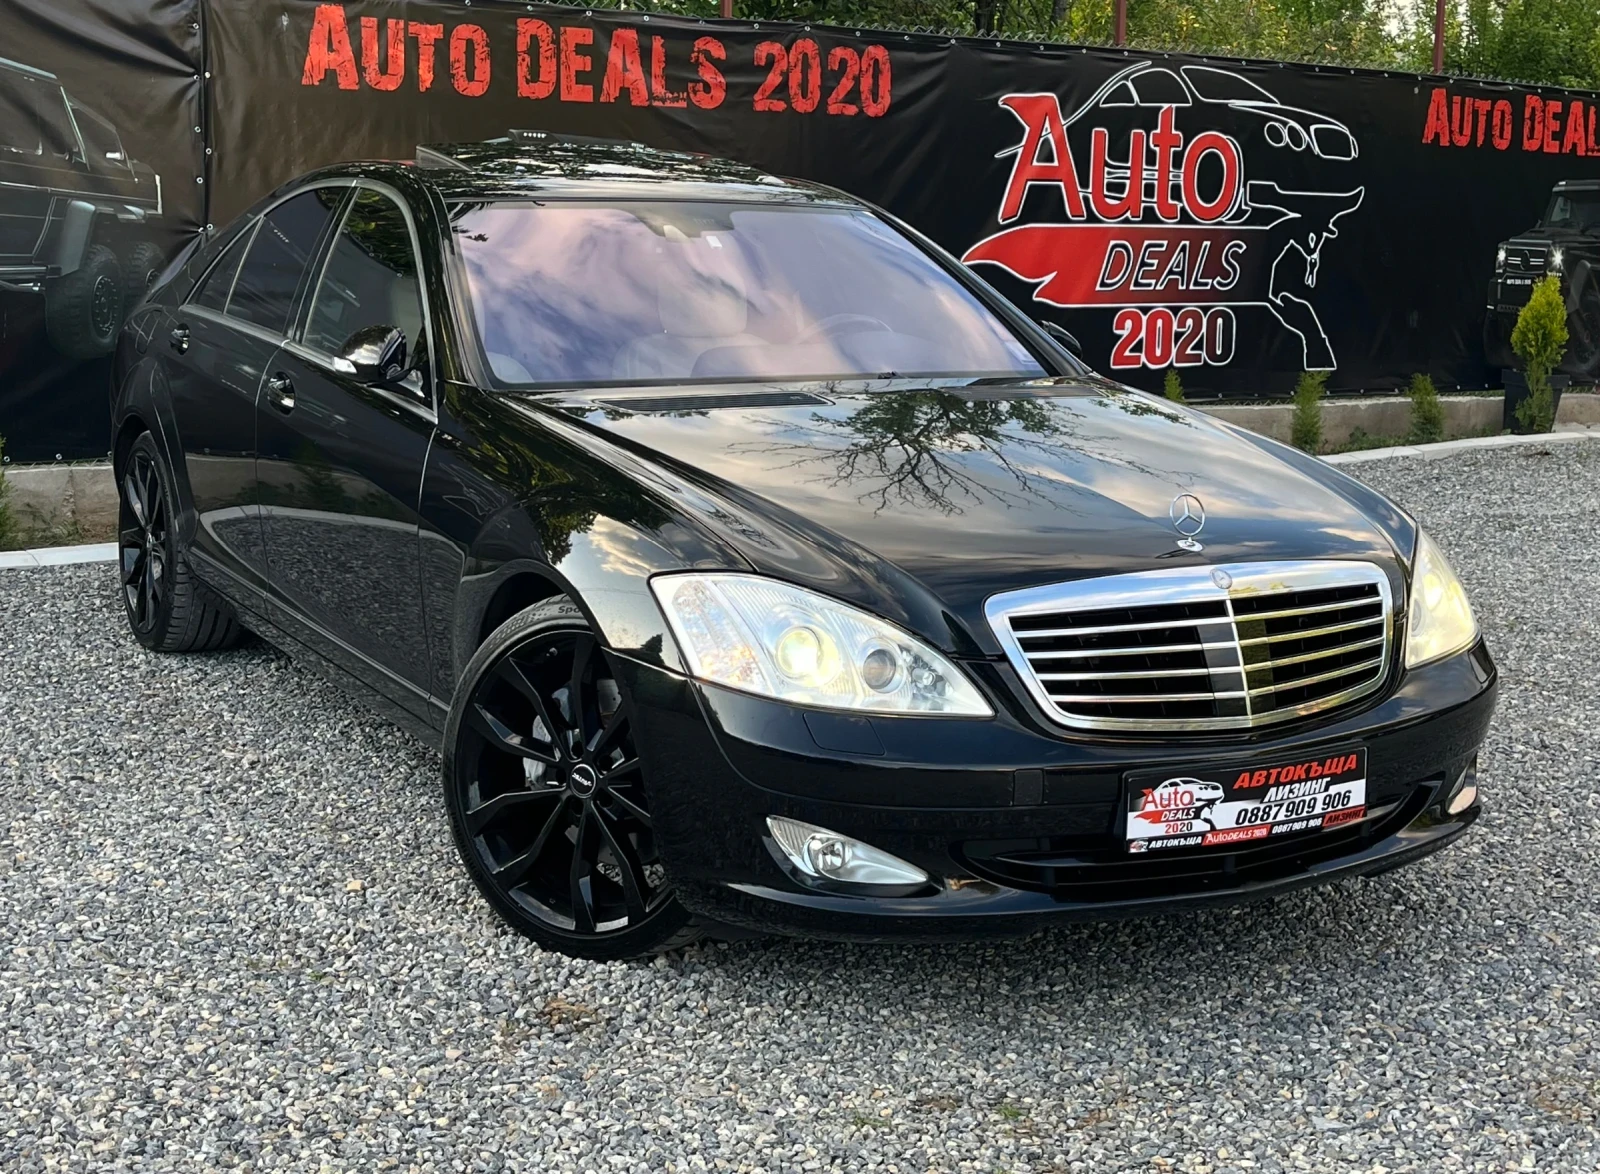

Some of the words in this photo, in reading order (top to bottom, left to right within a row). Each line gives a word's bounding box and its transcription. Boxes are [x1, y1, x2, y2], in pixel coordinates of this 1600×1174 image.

[301, 4, 492, 97] AUTO
[516, 17, 727, 109] DEALS
[752, 38, 892, 118] 2020
[1422, 87, 1513, 151] AUTO
[998, 92, 1239, 224] Auto
[1095, 240, 1247, 292] DEALS
[1110, 307, 1237, 370] 2020
[1232, 754, 1357, 789] АВТОКЪЩА
[1141, 787, 1195, 811] Auto
[1263, 777, 1331, 803] ЛИЗИНГ
[1321, 790, 1352, 811] 906
[1161, 808, 1196, 821] DEALS
[1165, 821, 1193, 834] 2020
[1148, 836, 1202, 849] АВТОКЪЩА
